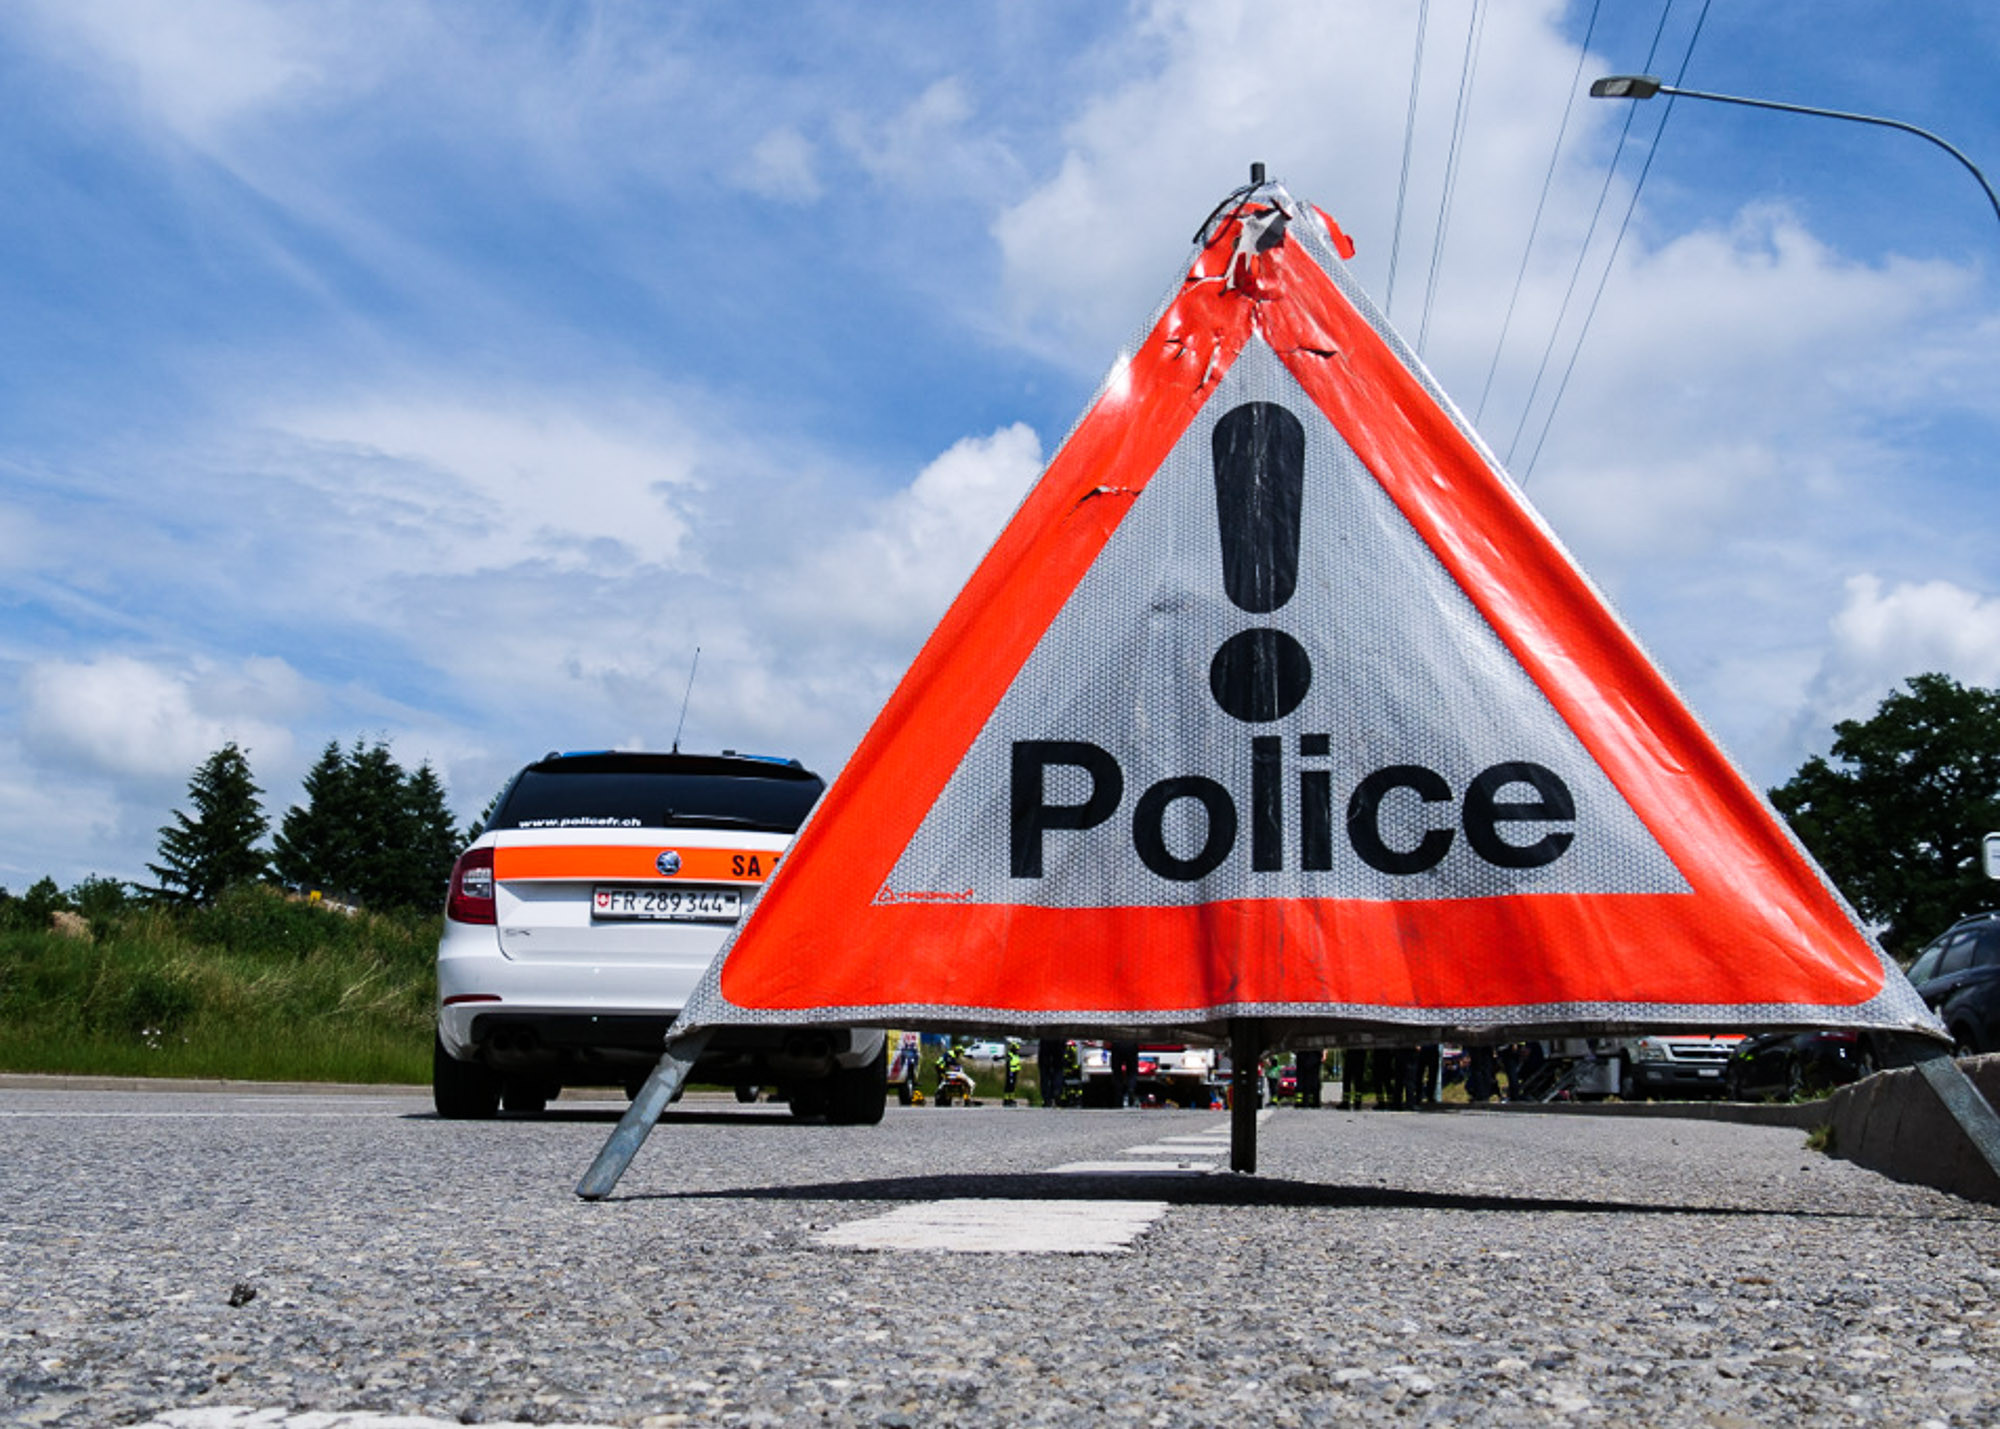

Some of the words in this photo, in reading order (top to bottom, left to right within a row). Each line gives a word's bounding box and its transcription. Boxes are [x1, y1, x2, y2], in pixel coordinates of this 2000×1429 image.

[1009, 734, 1577, 881] Police
[518, 817, 641, 828] www.policefr.ch
[732, 855, 761, 877] SA
